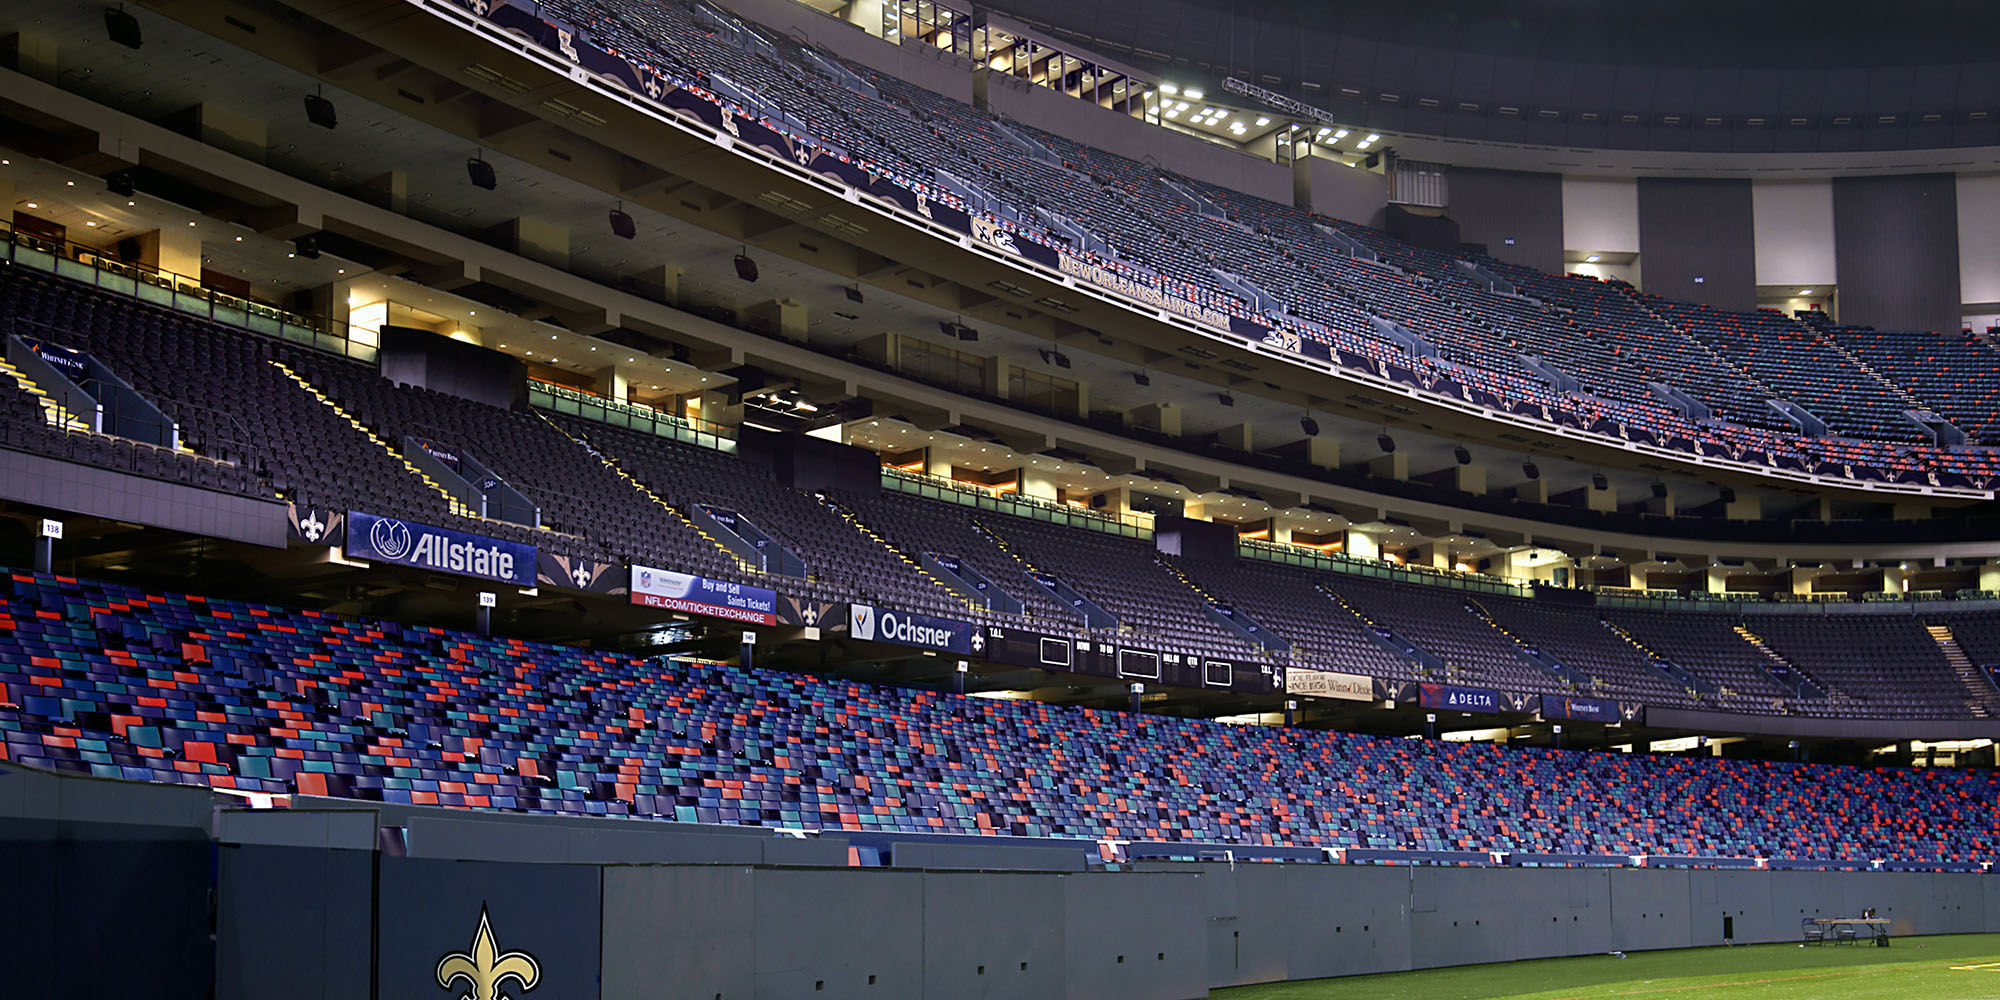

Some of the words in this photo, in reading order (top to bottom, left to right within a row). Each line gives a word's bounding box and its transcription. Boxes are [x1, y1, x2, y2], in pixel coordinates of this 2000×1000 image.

[47, 524, 60, 534] 138
[410, 532, 514, 580] Allstate
[702, 578, 714, 592] Buy
[715, 581, 728, 593] and
[728, 583, 740, 595] Sell
[644, 595, 765, 624] NFL.COM/TICKETEXCHANGE
[727, 594, 747, 608] Saints
[747, 597, 771, 612] Tickets!
[881, 612, 951, 647] Ochsner
[1459, 693, 1492, 706] DELTA
